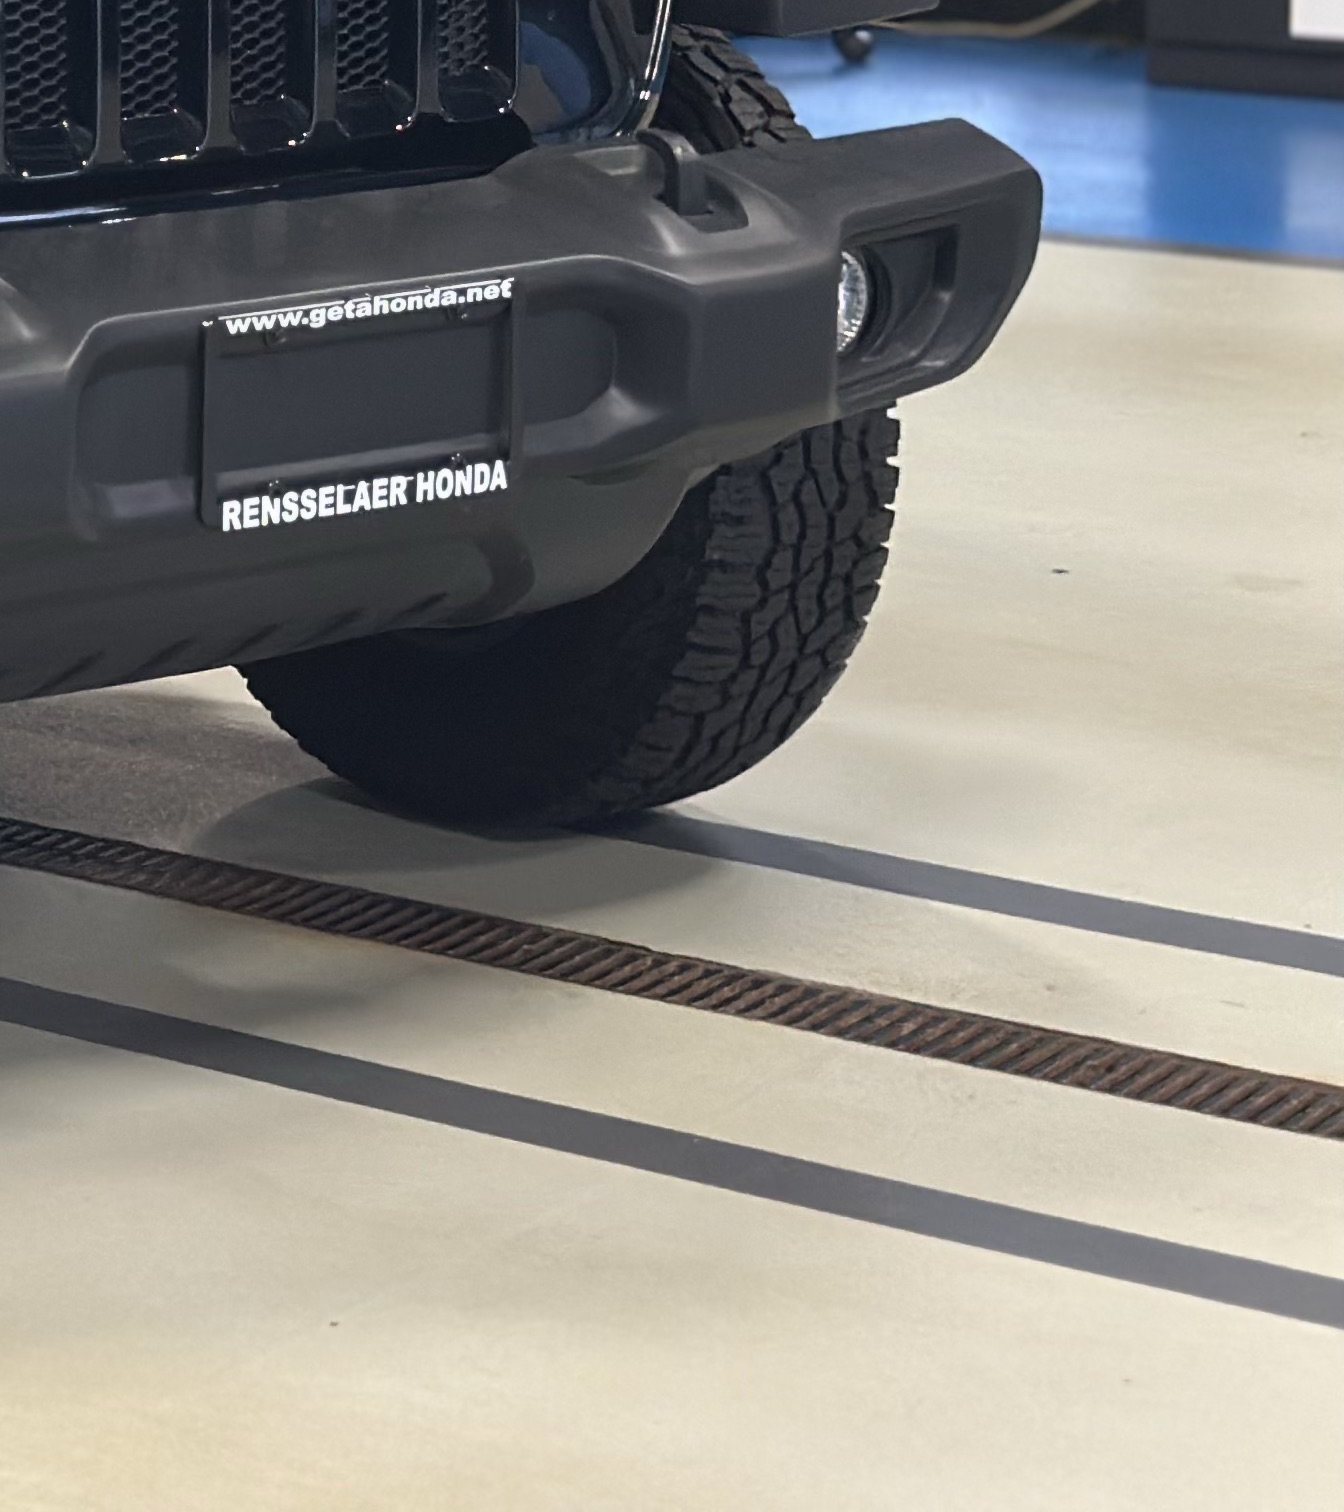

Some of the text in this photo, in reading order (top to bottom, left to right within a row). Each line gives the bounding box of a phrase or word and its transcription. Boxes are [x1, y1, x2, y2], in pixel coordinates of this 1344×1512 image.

[226, 280, 513, 334] www.getahonda.net
[222, 459, 508, 532] RENSSELAER HONDA
